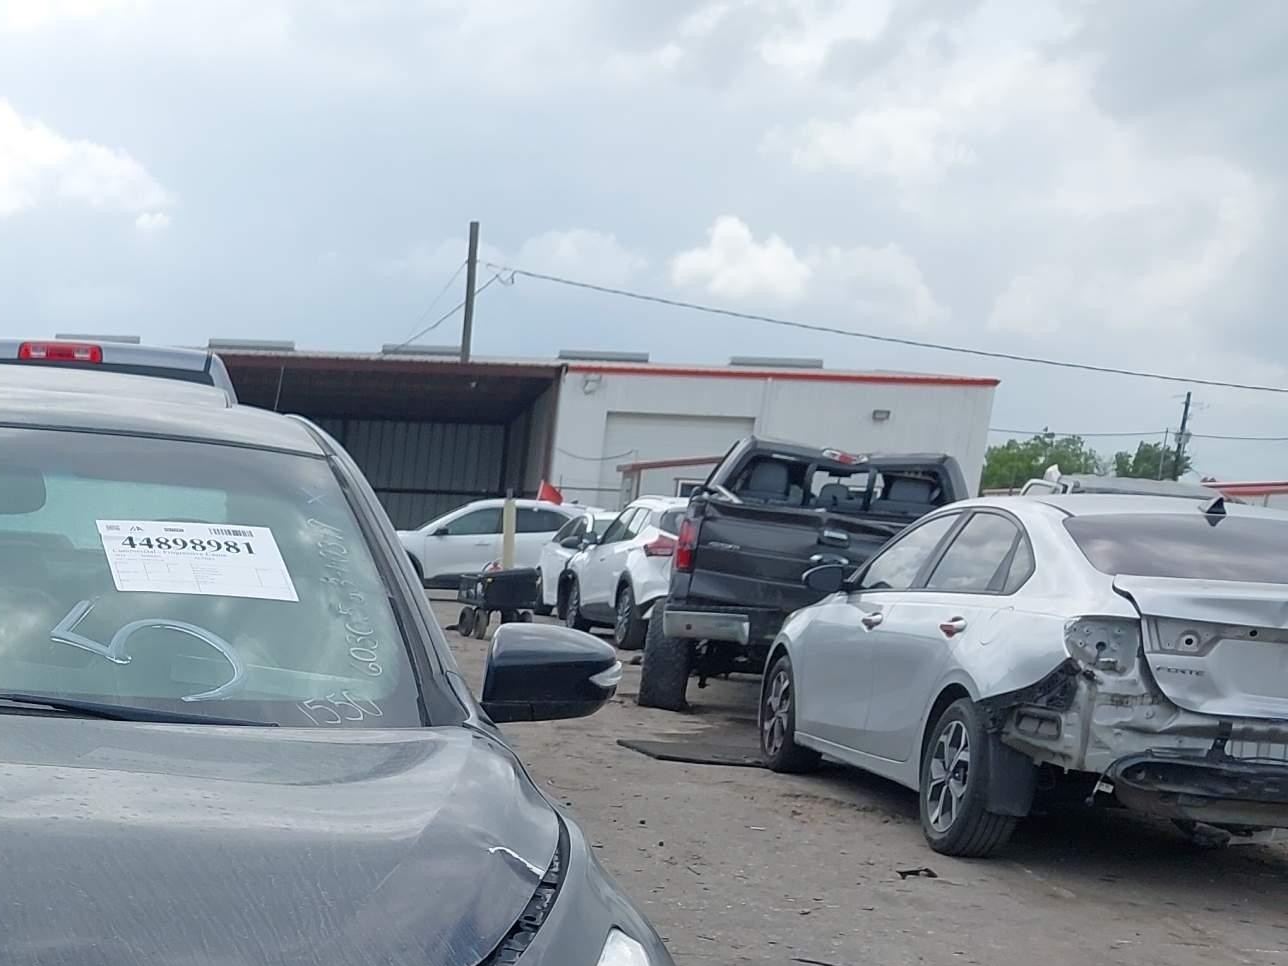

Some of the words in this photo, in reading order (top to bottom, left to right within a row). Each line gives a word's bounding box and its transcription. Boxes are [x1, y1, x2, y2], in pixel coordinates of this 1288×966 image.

[120, 535, 257, 555] 44898981
[50, 597, 248, 702] 5
[1155, 665, 1206, 677] FORTE
